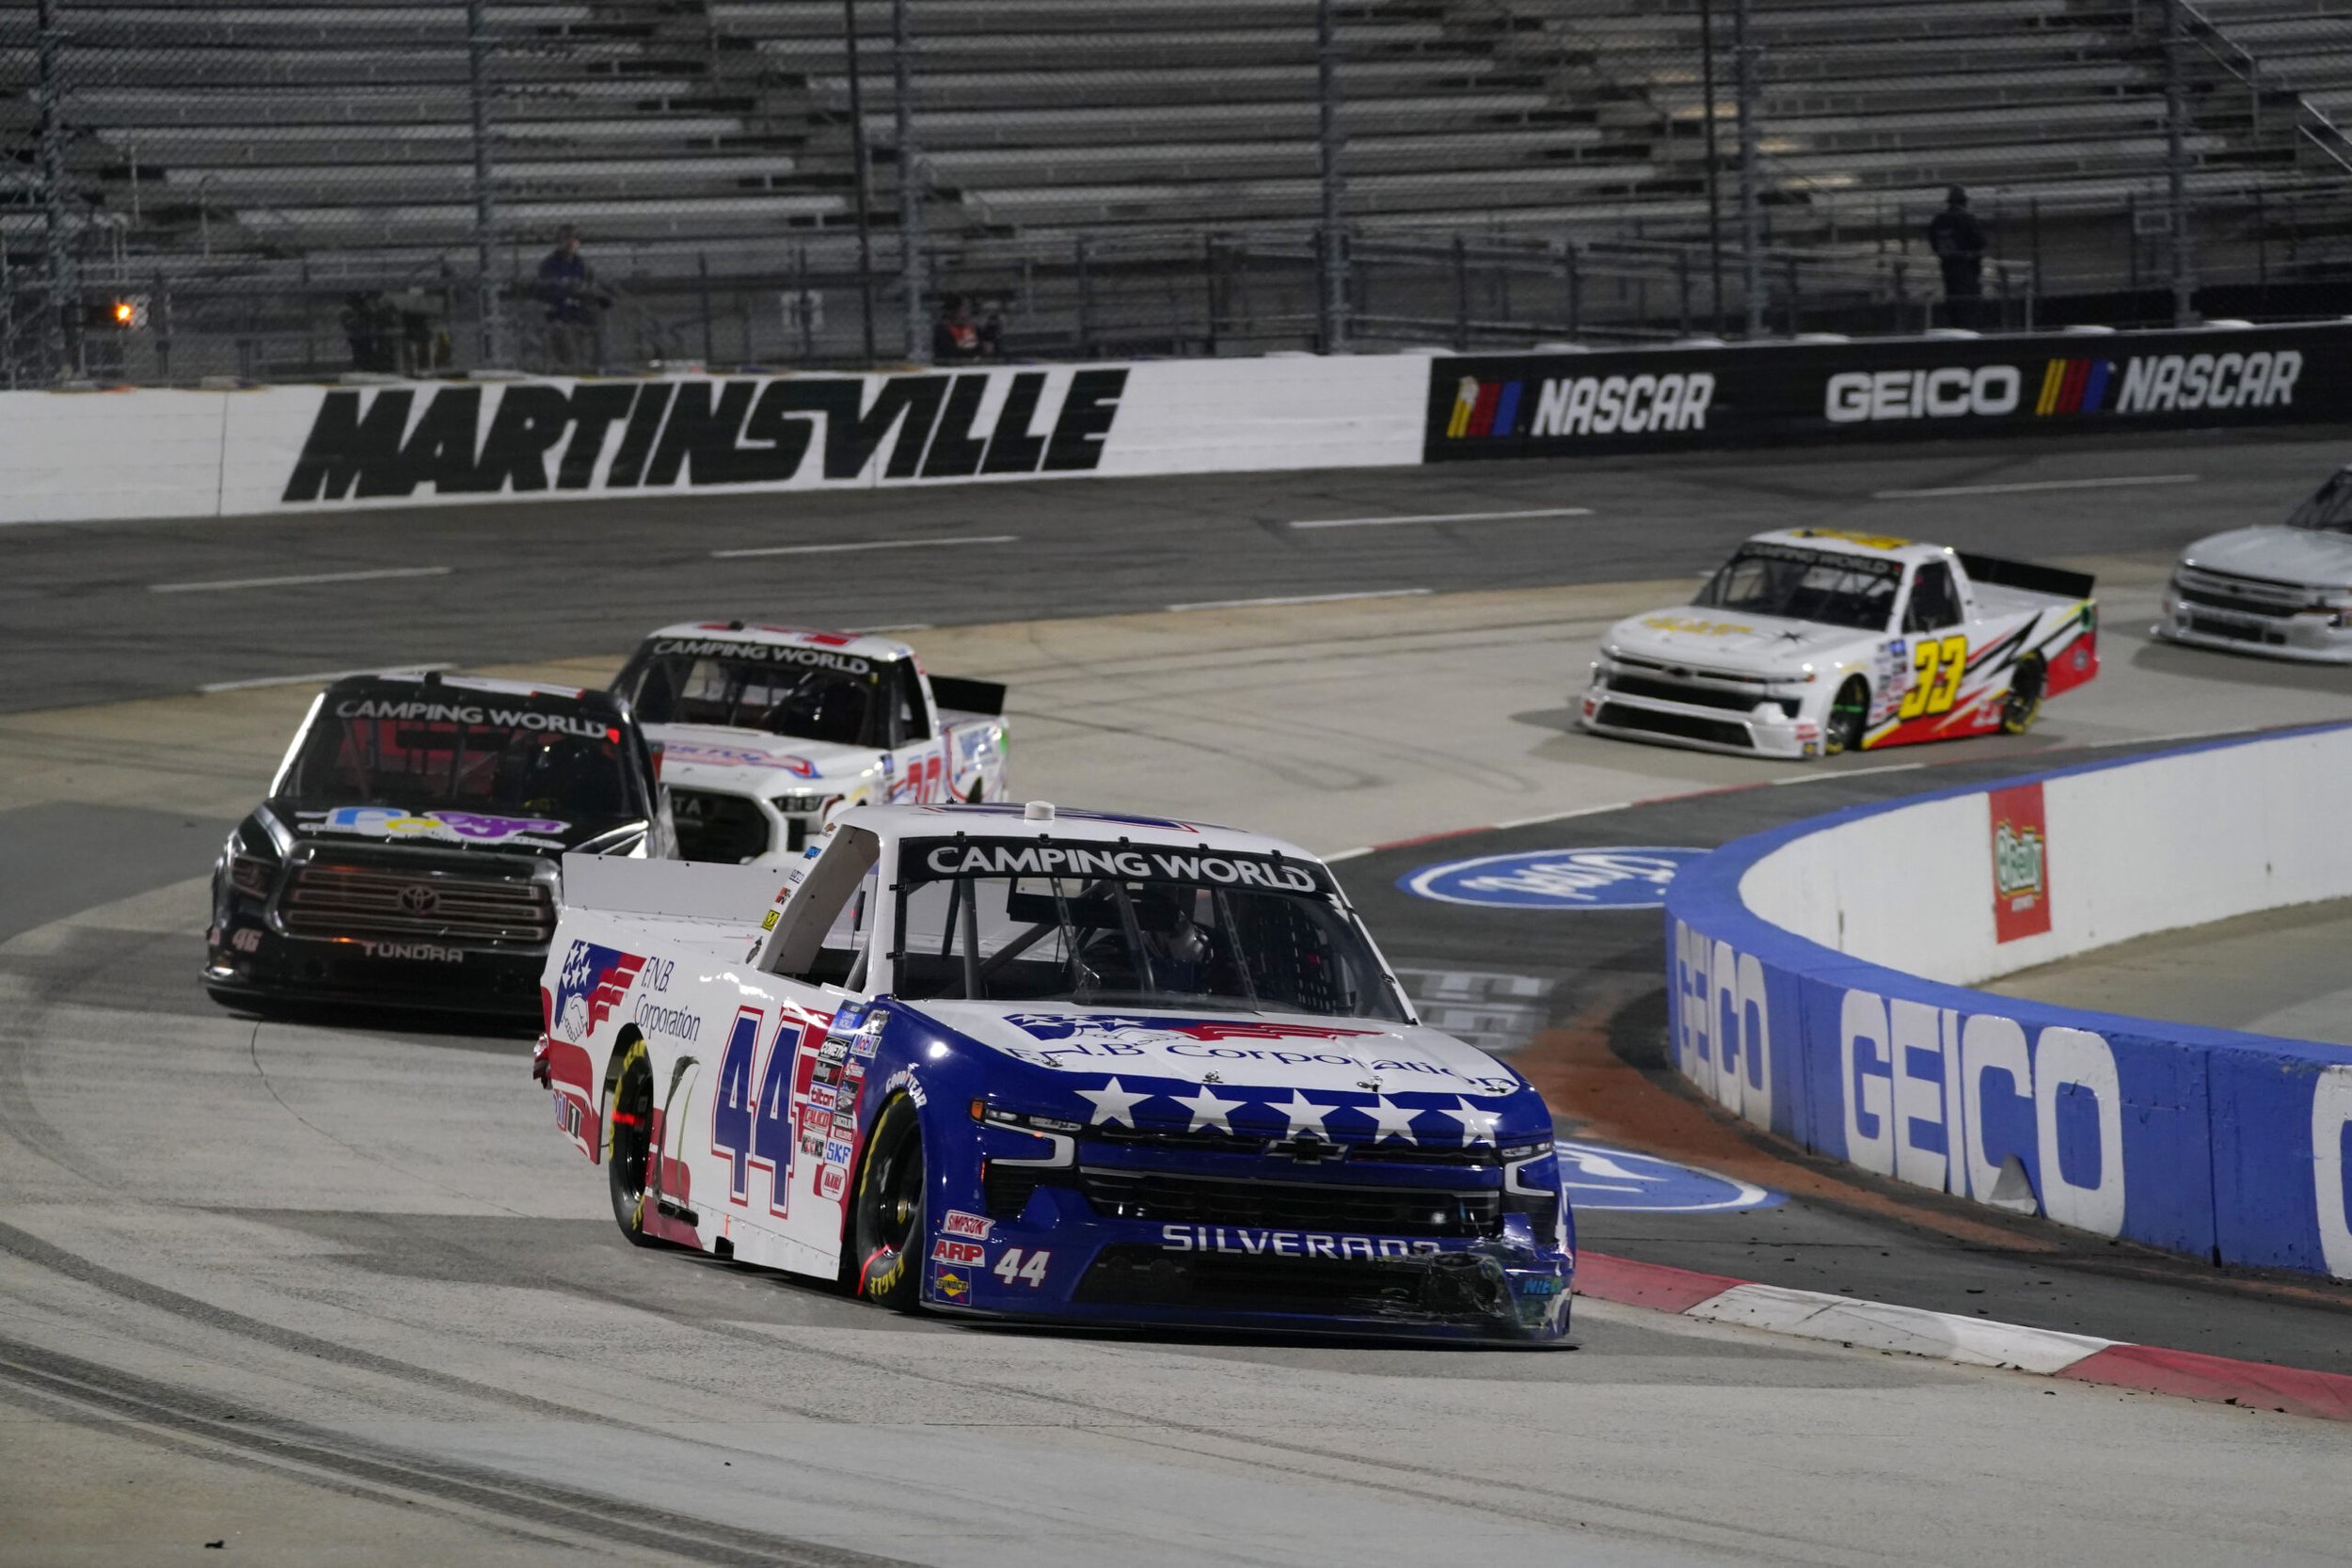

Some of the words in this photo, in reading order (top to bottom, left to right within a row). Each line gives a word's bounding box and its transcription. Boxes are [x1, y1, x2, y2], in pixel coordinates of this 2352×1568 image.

[1825, 364, 2021, 422] GEICO
[2116, 350, 2303, 414] NASCAR
[1531, 372, 1715, 436] NASCAR
[282, 368, 1131, 503] MARTINSVILLE
[653, 640, 768, 659] CAMPING
[772, 646, 870, 674] WORLD
[1898, 633, 1967, 721] 33
[336, 700, 484, 723] CAMPING
[488, 708, 607, 738] WORLD
[927, 847, 1152, 878] CAMPING
[1151, 853, 1316, 893] WORLD
[231, 927, 263, 953] 46
[360, 942, 464, 963] TUNDRA
[641, 956, 675, 993] F.N.B.
[634, 993, 701, 1042] Corporation
[1676, 918, 1772, 1132] GEICO
[711, 1006, 806, 1220] 44
[1841, 988, 2125, 1238] GEICO
[826, 1142, 850, 1164] SKF
[947, 1214, 990, 1235] SIMPSON
[934, 1240, 983, 1262] ARP
[993, 1247, 1051, 1288] 44
[936, 1279, 969, 1292] SUNOCO
